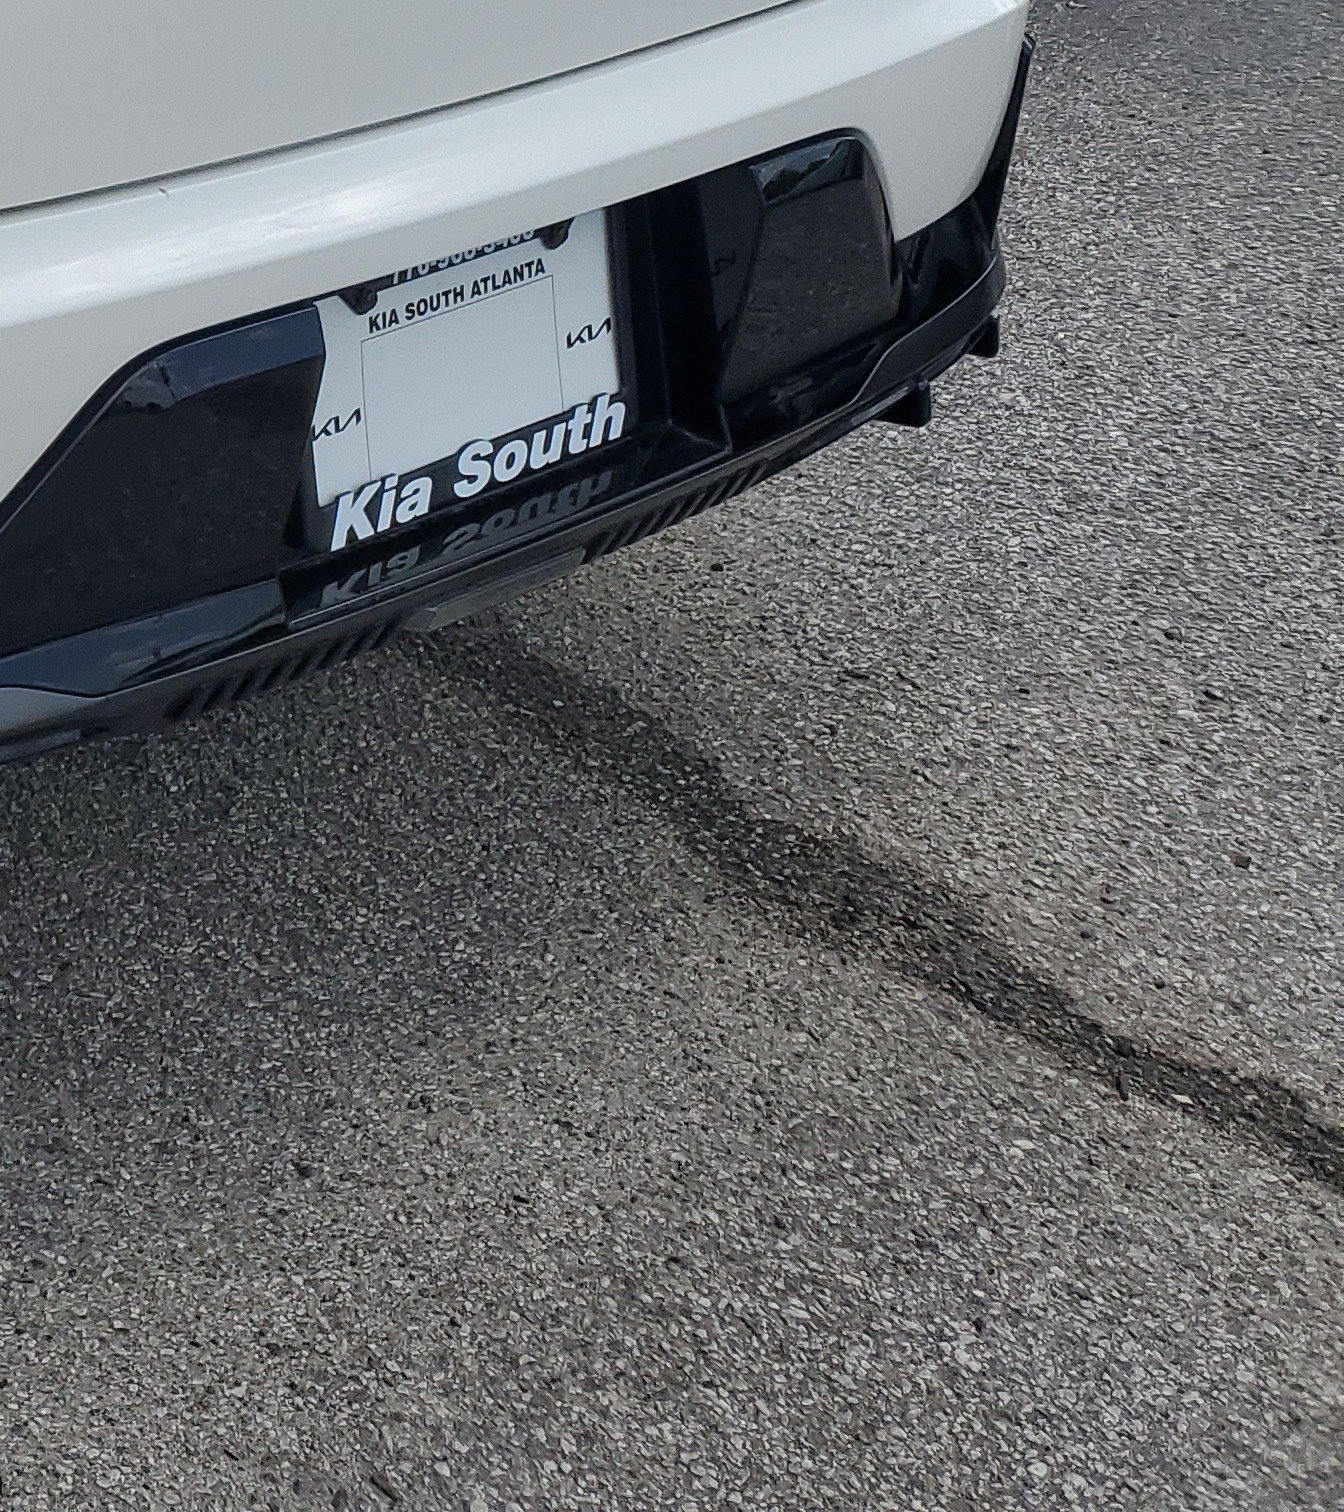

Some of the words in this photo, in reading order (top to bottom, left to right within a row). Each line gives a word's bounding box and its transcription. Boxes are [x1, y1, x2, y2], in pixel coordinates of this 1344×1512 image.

[367, 307, 400, 334] KIA
[404, 284, 465, 321] SOUTH
[470, 257, 546, 299] ATLANTA
[566, 317, 612, 349] KIA
[330, 472, 433, 552] Kia
[453, 392, 627, 498] South
